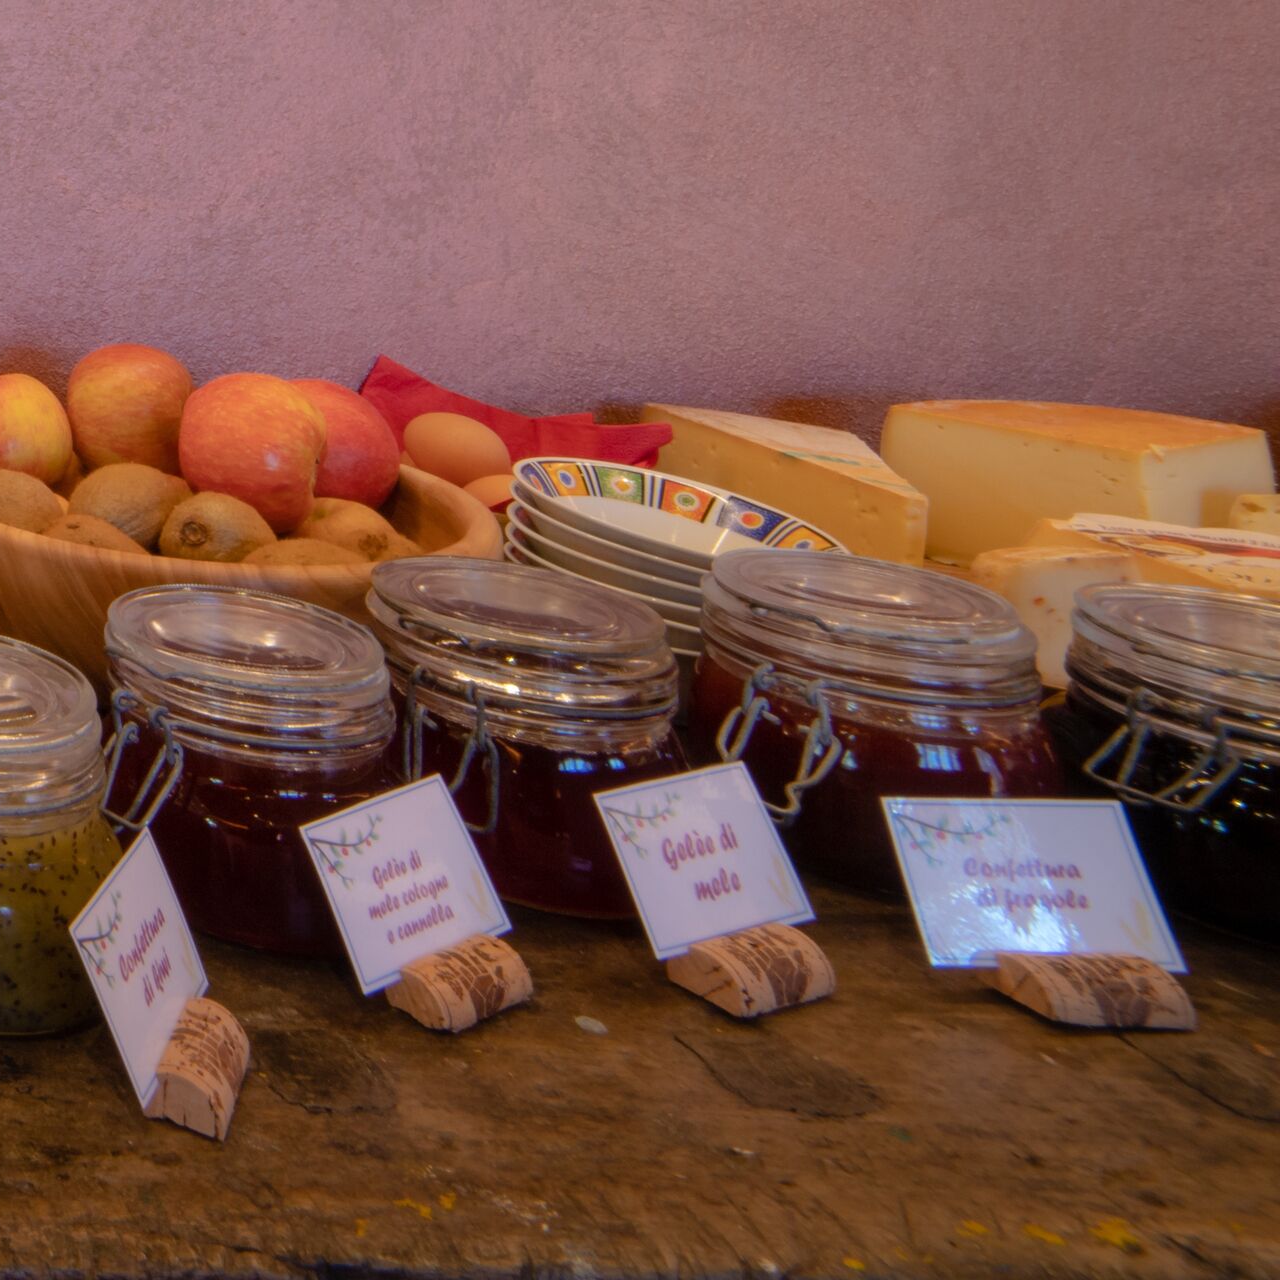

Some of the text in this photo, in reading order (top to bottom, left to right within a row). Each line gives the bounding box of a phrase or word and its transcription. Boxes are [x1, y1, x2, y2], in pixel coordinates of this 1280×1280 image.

[719, 821, 739, 852] di
[409, 848, 423, 871] di
[962, 856, 1083, 882] Confettura
[368, 874, 449, 920] mele cotogne
[693, 867, 743, 903] mele
[977, 886, 1089, 914] di fragole
[386, 902, 455, 945] e cannella
[118, 906, 167, 982] Confettura
[142, 973, 155, 1008] di
